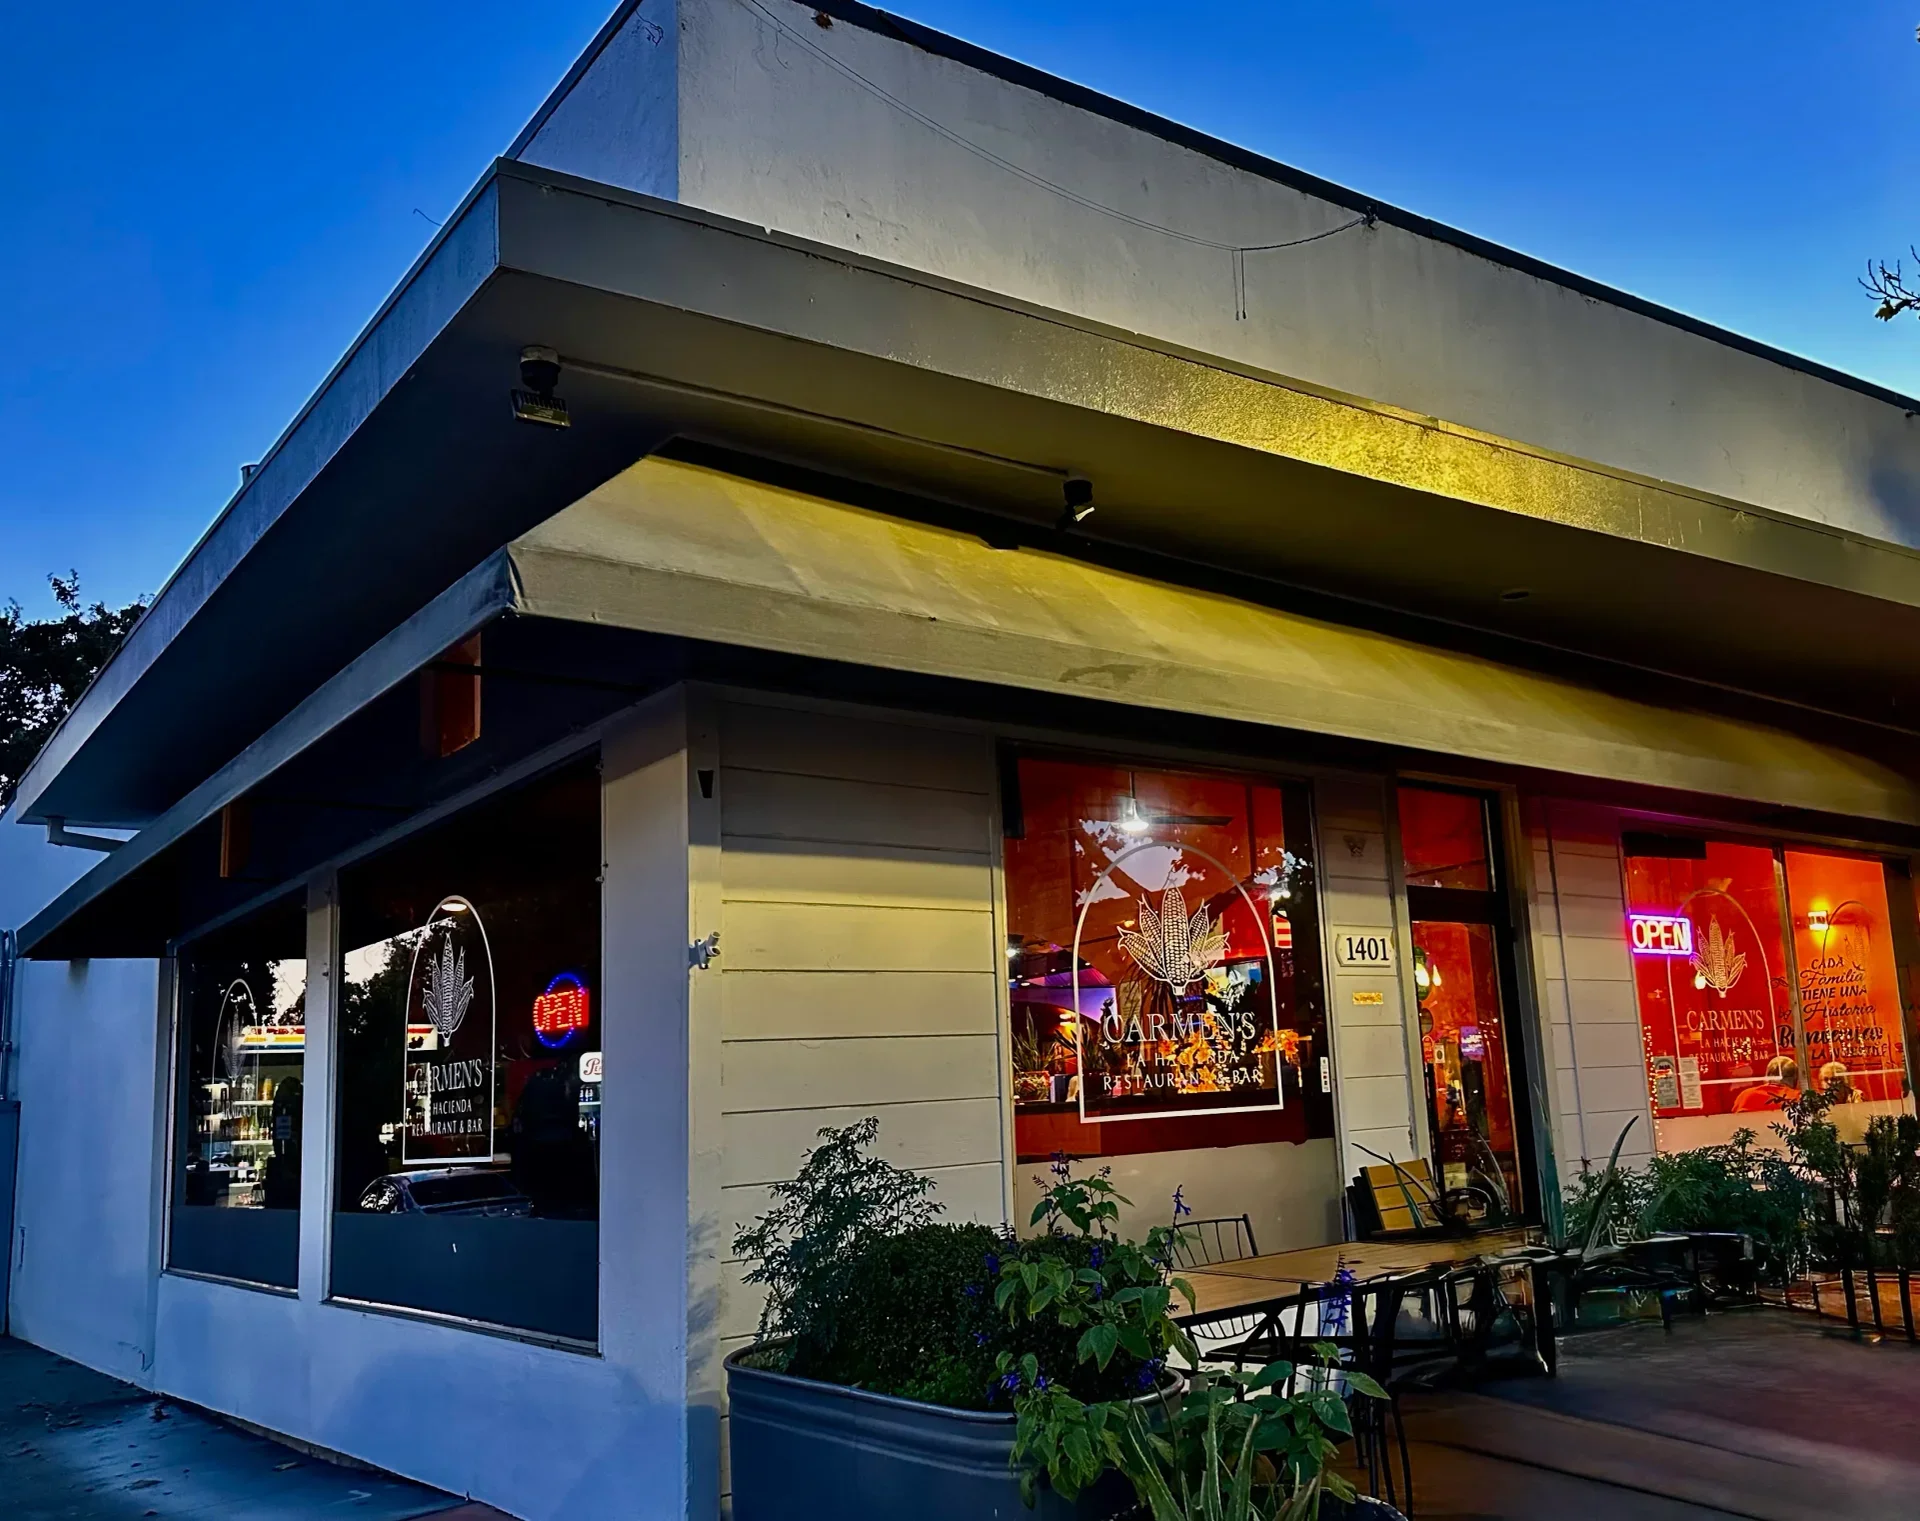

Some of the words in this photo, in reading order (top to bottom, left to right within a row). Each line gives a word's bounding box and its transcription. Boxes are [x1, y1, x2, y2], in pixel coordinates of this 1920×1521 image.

[1632, 921, 1687, 950] OPEN
[1346, 937, 1390, 962] 1401
[1811, 956, 1844, 970] CADA
[1800, 969, 1865, 989] Familia
[1802, 987, 1836, 1000] TIENE
[533, 990, 583, 1031] OPEN
[1103, 1012, 1256, 1044] CARMEN'S
[1686, 1010, 1765, 1031] CARMEN'S
[1713, 1037, 1757, 1048] HACIENA
[1126, 1051, 1146, 1068] LA
[1689, 1052, 1743, 1064] ESTAURAT
[1103, 1072, 1208, 1091] RESTAURAN
[432, 1099, 472, 1115] HACIENDA
[411, 1120, 457, 1137] RESAURANT
[467, 1118, 483, 1133] BAR
